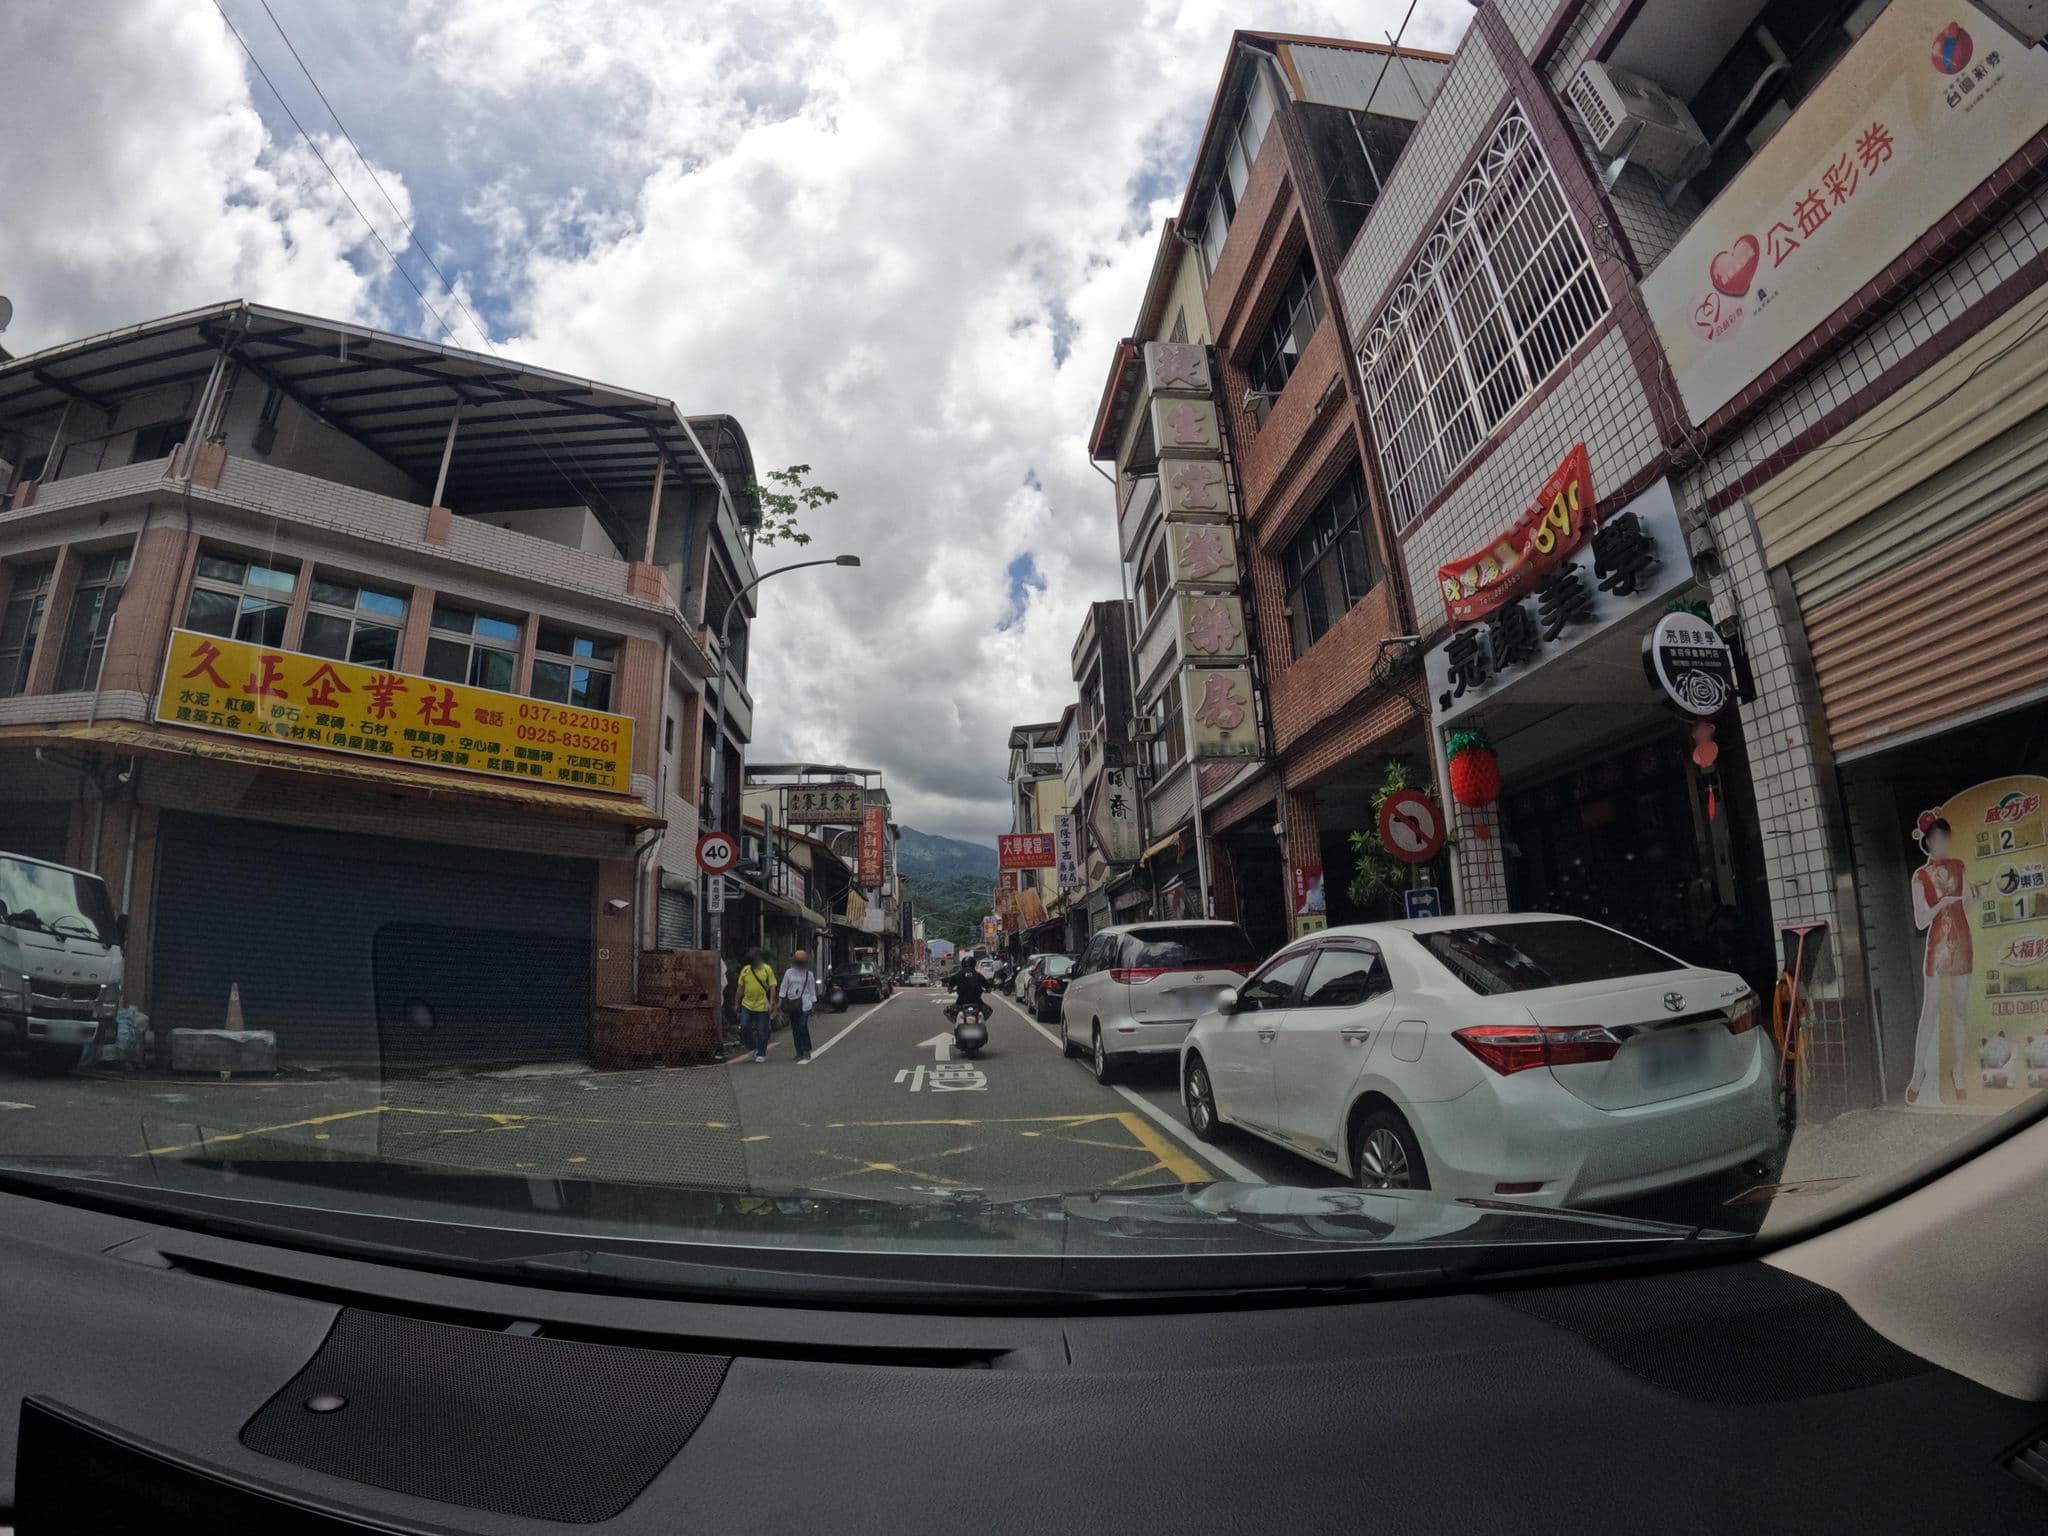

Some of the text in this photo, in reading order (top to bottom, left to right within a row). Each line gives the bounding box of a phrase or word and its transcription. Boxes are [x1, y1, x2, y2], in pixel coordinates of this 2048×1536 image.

[1765, 121, 1896, 269] 公益彩券
[183, 640, 461, 729] 久正企業社
[519, 703, 620, 735] 037-822036
[517, 725, 618, 754] 0925-835261
[705, 845, 729, 860] 40
[2001, 830, 2013, 849] 2
[2014, 898, 2024, 918] 1
[894, 1063, 988, 1092] 慢
